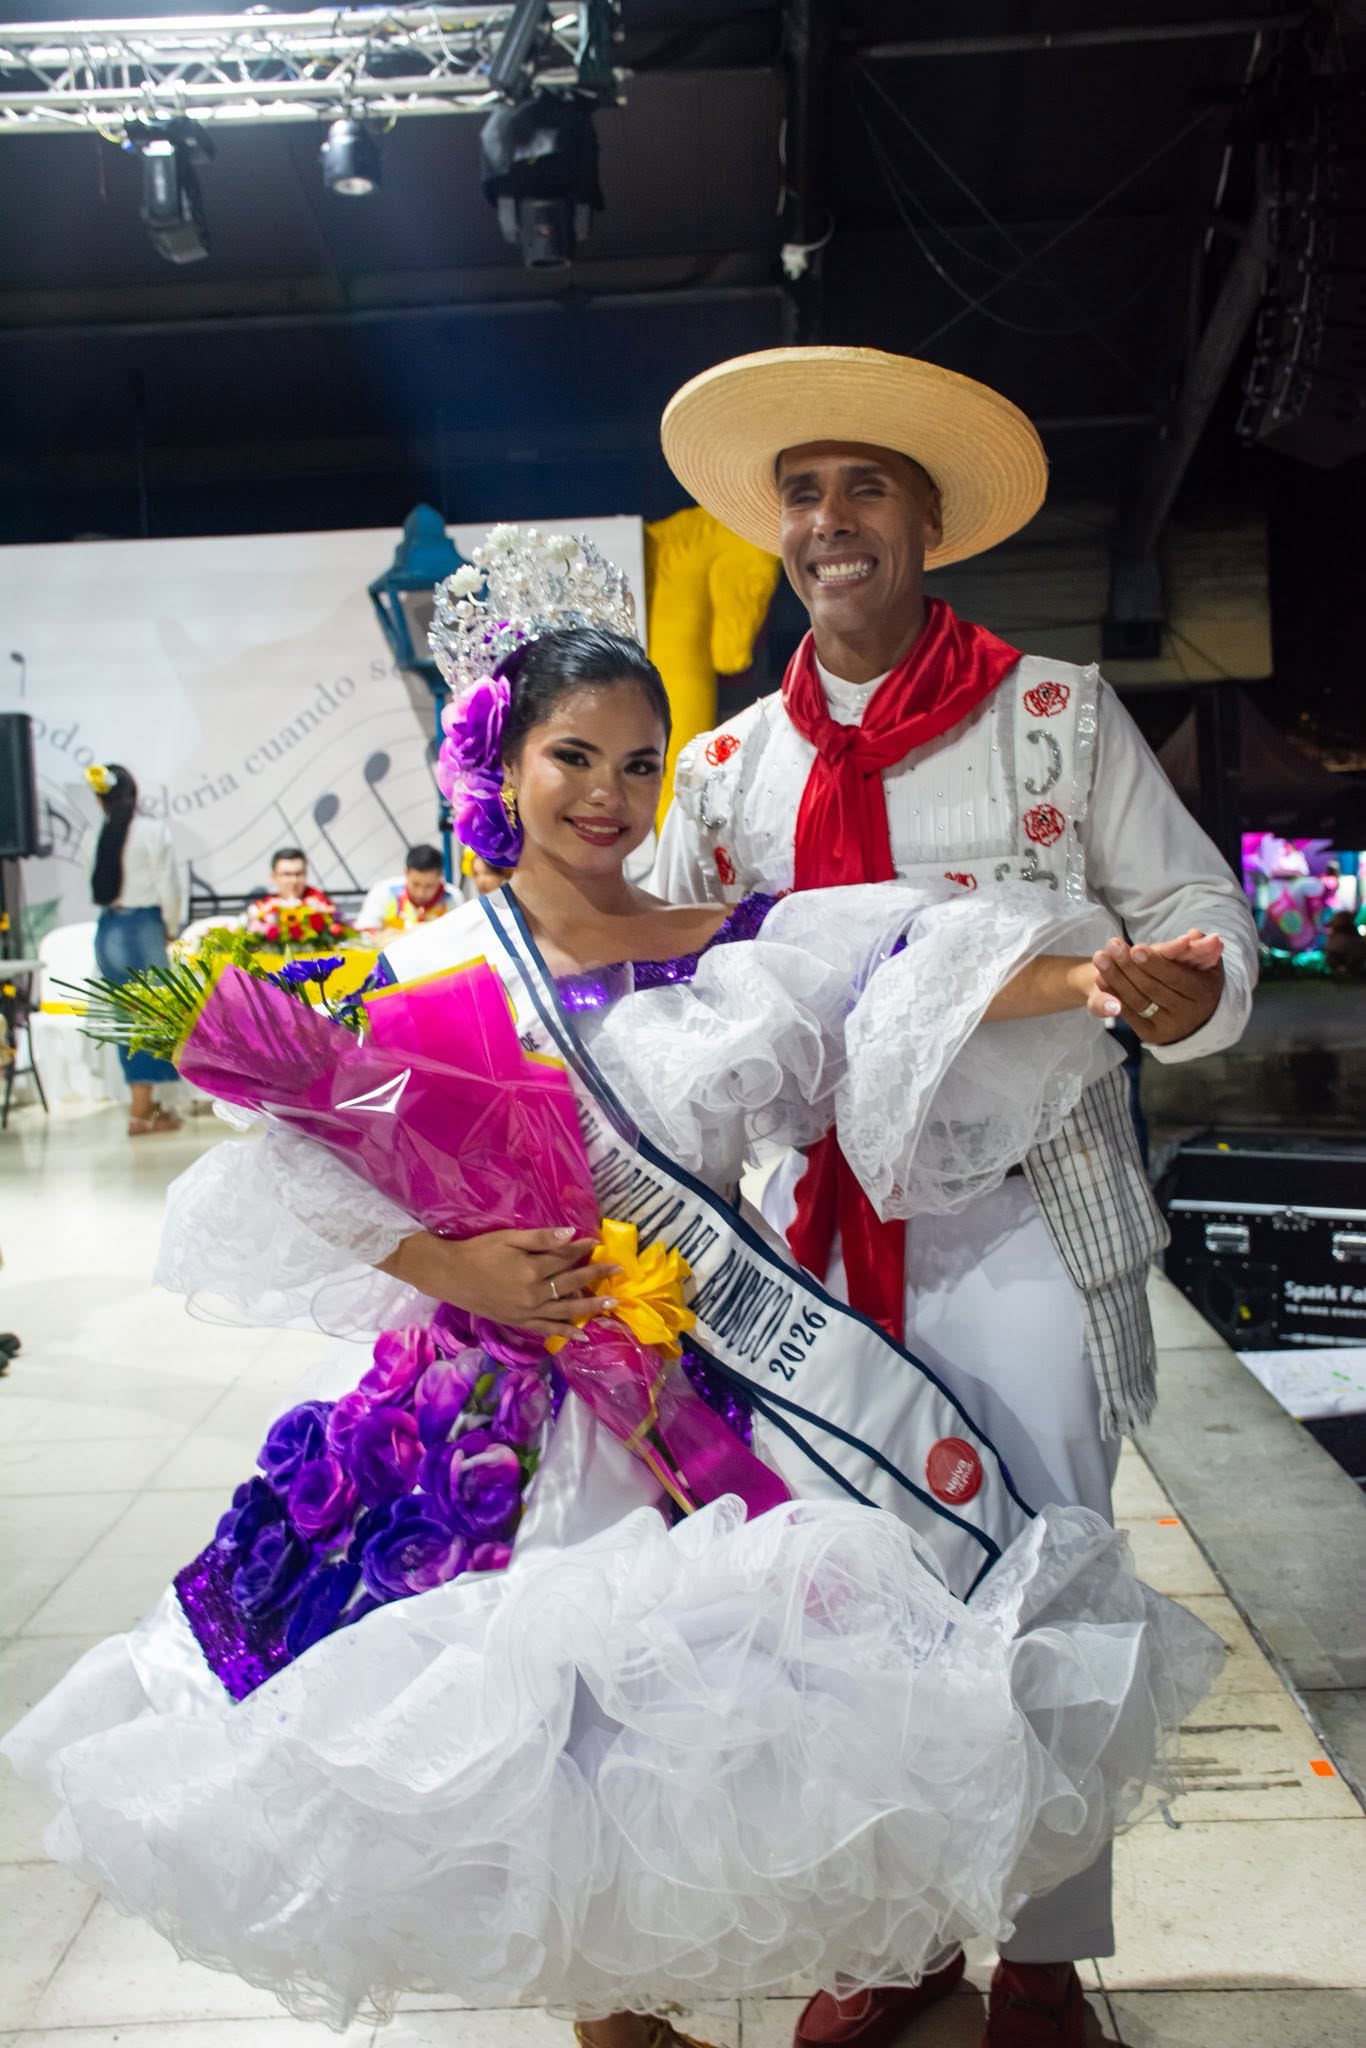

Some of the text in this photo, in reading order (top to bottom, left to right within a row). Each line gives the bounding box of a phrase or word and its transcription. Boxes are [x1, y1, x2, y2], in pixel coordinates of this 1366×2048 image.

[244, 673, 356, 776] cuando
[687, 1247, 793, 1364] BAMBUCO
[1284, 1280, 1338, 1303] Spark
[768, 1305, 828, 1382] 2026
